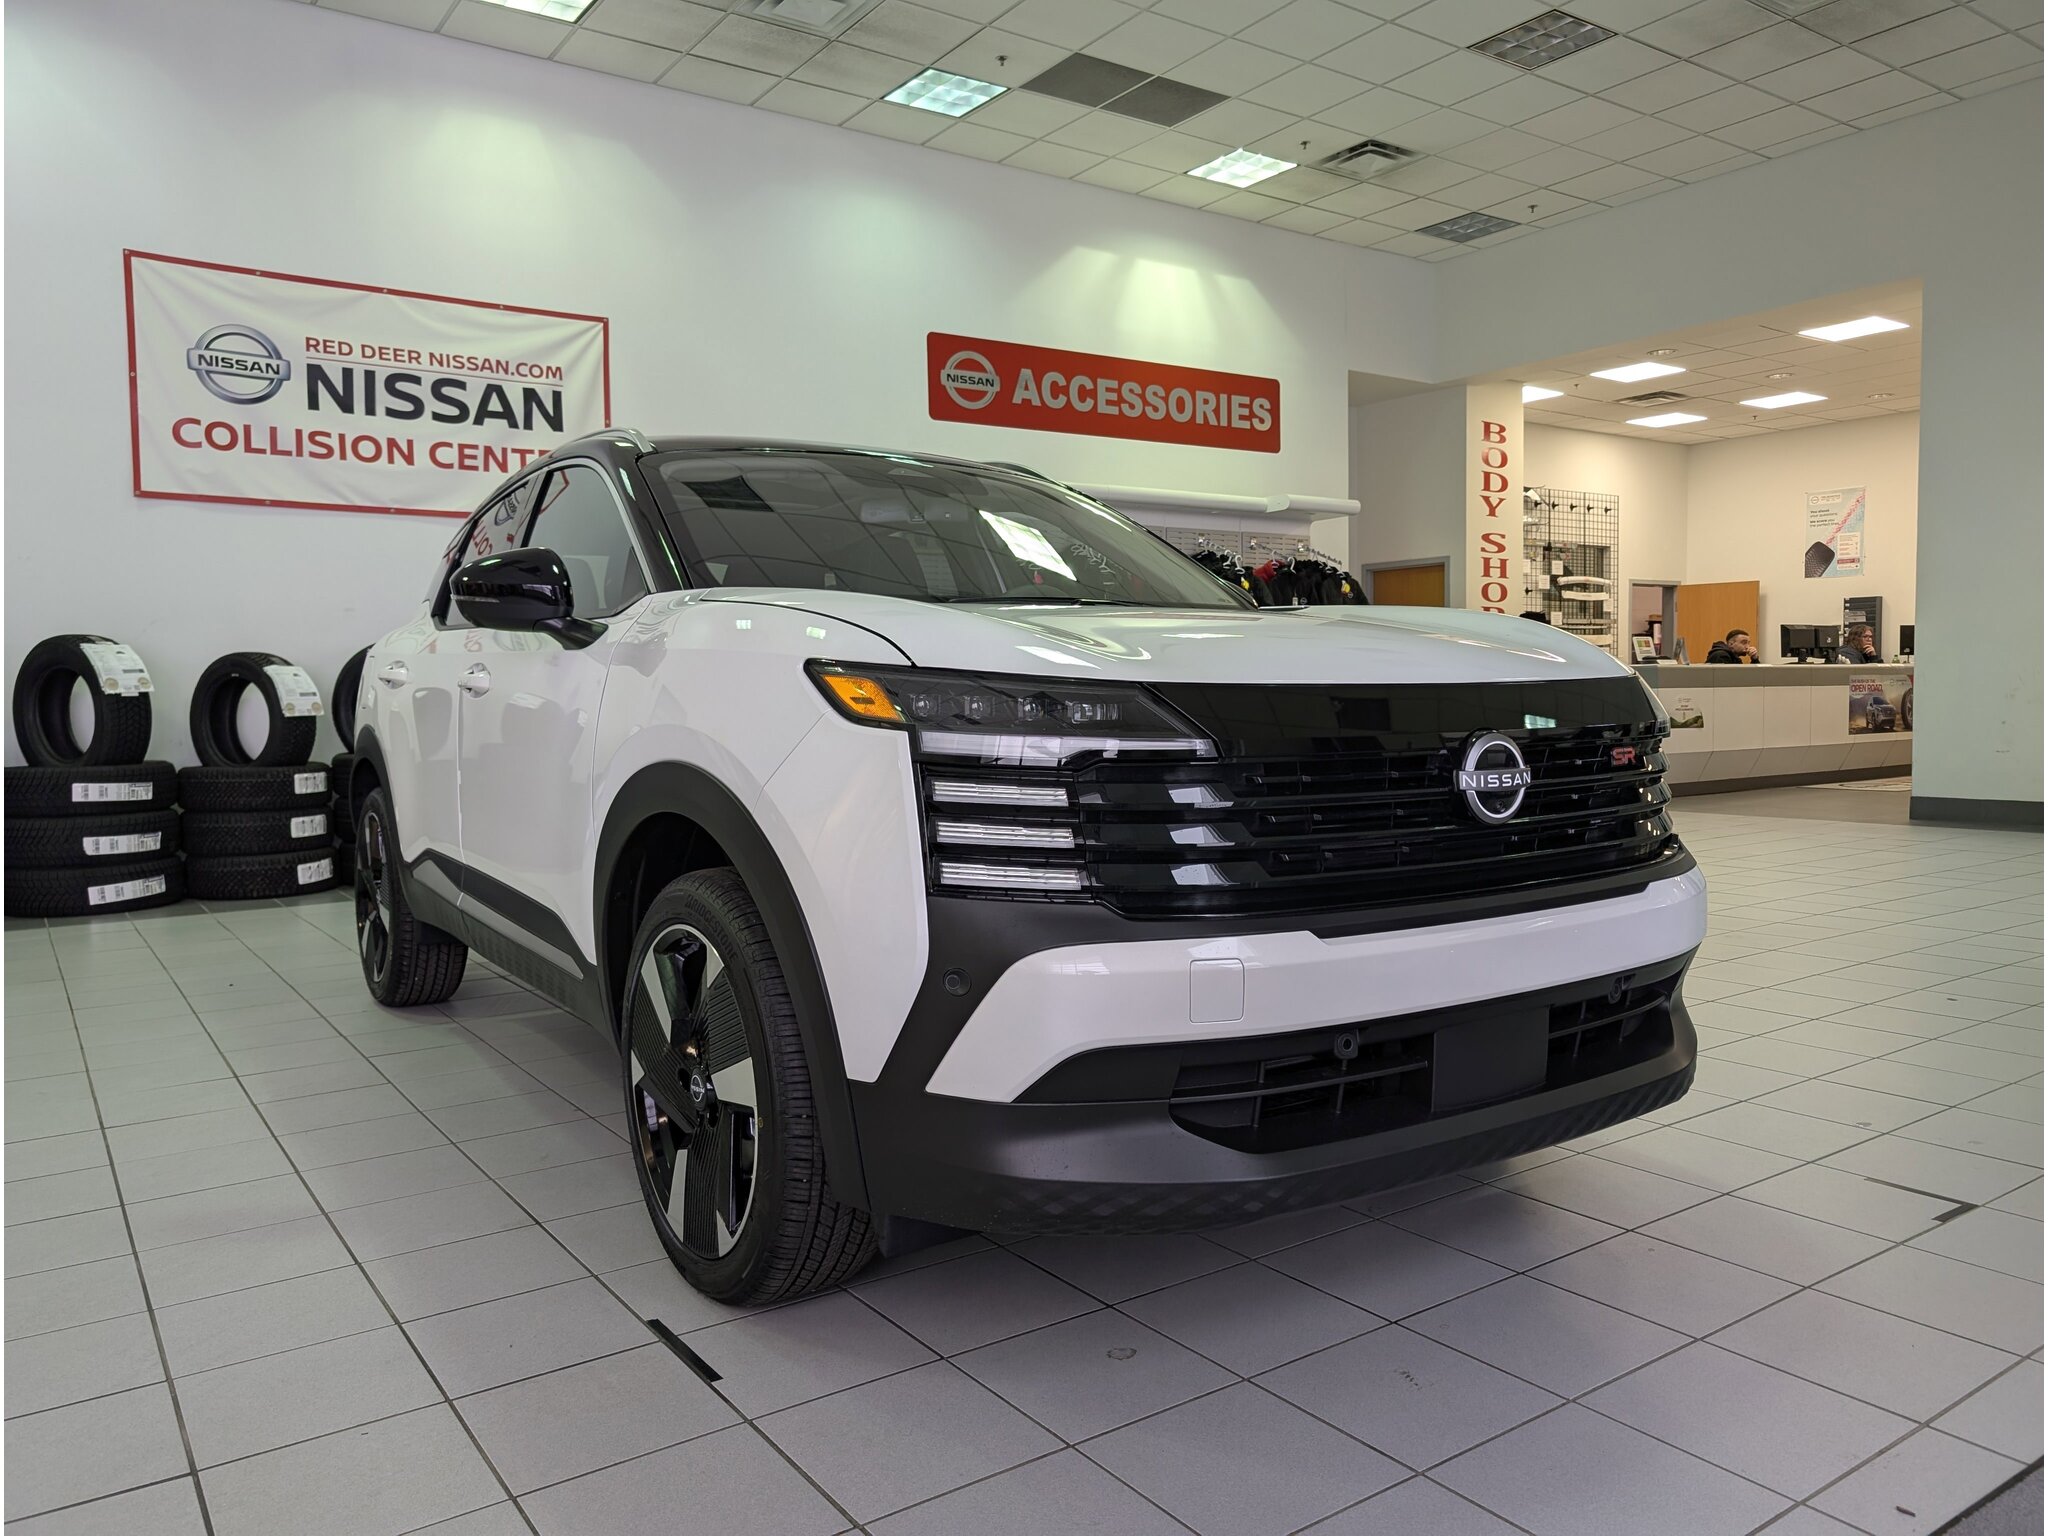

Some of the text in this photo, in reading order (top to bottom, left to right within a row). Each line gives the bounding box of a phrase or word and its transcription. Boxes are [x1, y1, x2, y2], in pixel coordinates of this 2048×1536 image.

[197, 353, 281, 376] NISSAN
[305, 336, 564, 381] RED DEER NISSAN.COM
[946, 372, 995, 388] NISSAN
[305, 363, 565, 433] NISSAN
[1011, 367, 1273, 432] ACCESSORIES
[171, 417, 552, 474] COLLISION CENT
[1479, 420, 1509, 518] BODY
[1851, 684, 1867, 693] OPEN
[1611, 746, 1637, 766] SR
[1462, 770, 1531, 788] NISSAN
[684, 893, 739, 964] BRIDGESTONE
